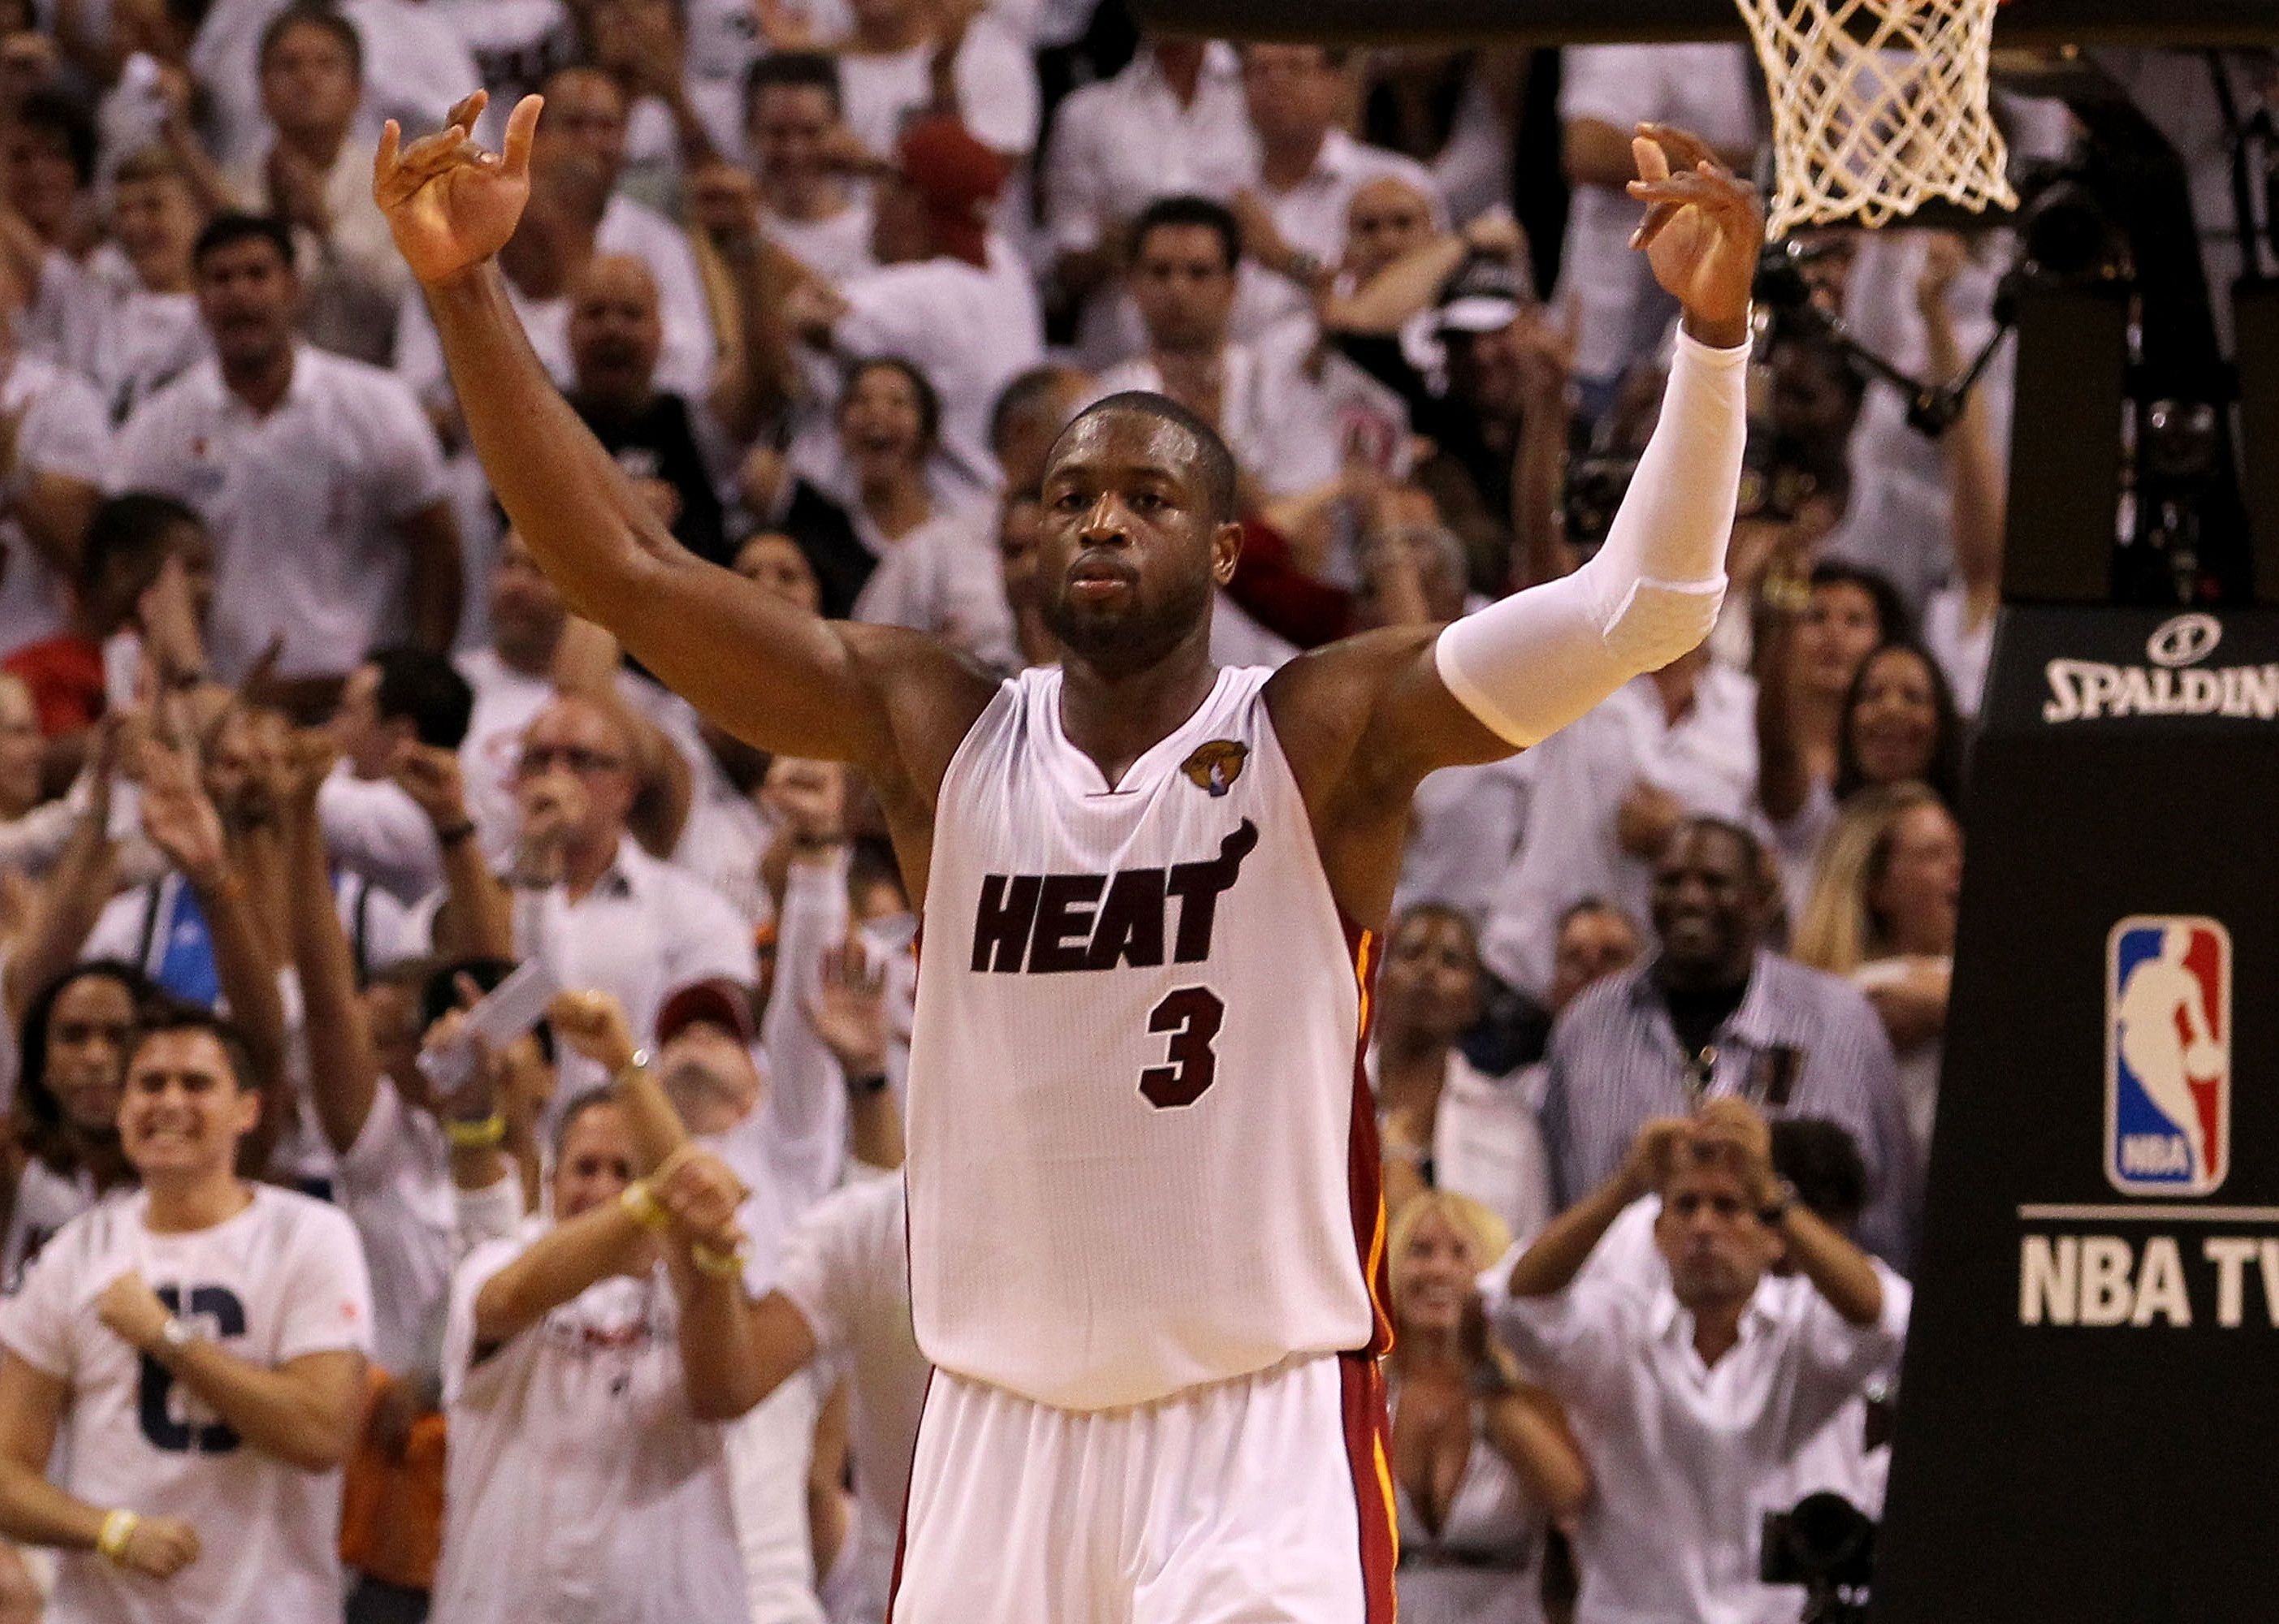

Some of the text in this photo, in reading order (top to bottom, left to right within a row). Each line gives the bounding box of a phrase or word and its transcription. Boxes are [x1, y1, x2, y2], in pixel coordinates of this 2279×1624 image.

[970, 816, 1259, 974] HEAT
[1138, 985, 1226, 1111] 3
[2020, 1235, 2192, 1327] NBA
